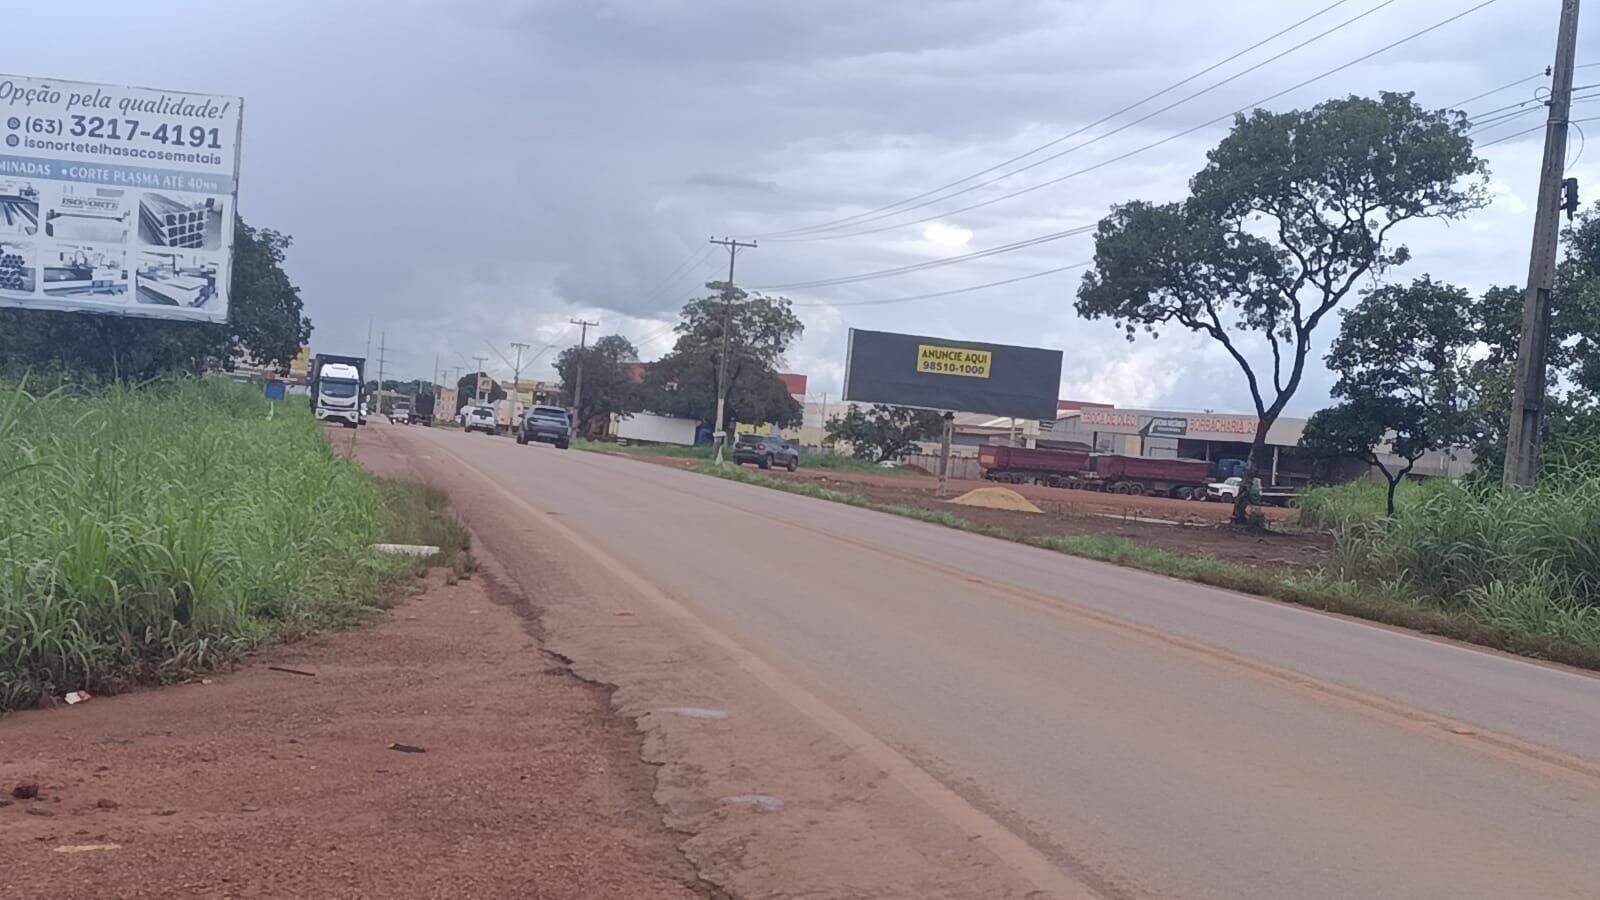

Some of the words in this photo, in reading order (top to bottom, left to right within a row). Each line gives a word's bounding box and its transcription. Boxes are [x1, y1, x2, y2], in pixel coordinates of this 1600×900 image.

[0, 81, 61, 106] Opção
[65, 88, 112, 111] pela
[118, 96, 230, 119] qualidade!
[25, 116, 63, 136] (63)
[69, 114, 222, 149] 3217-4191
[24, 135, 221, 165] isonortetelhasacosemetais
[69, 166, 109, 181] CORTE
[113, 170, 160, 185] PLASMA
[922, 349, 963, 361] ANUNCIE
[965, 353, 988, 364] AQUI
[923, 361, 985, 374] 98510-1000
